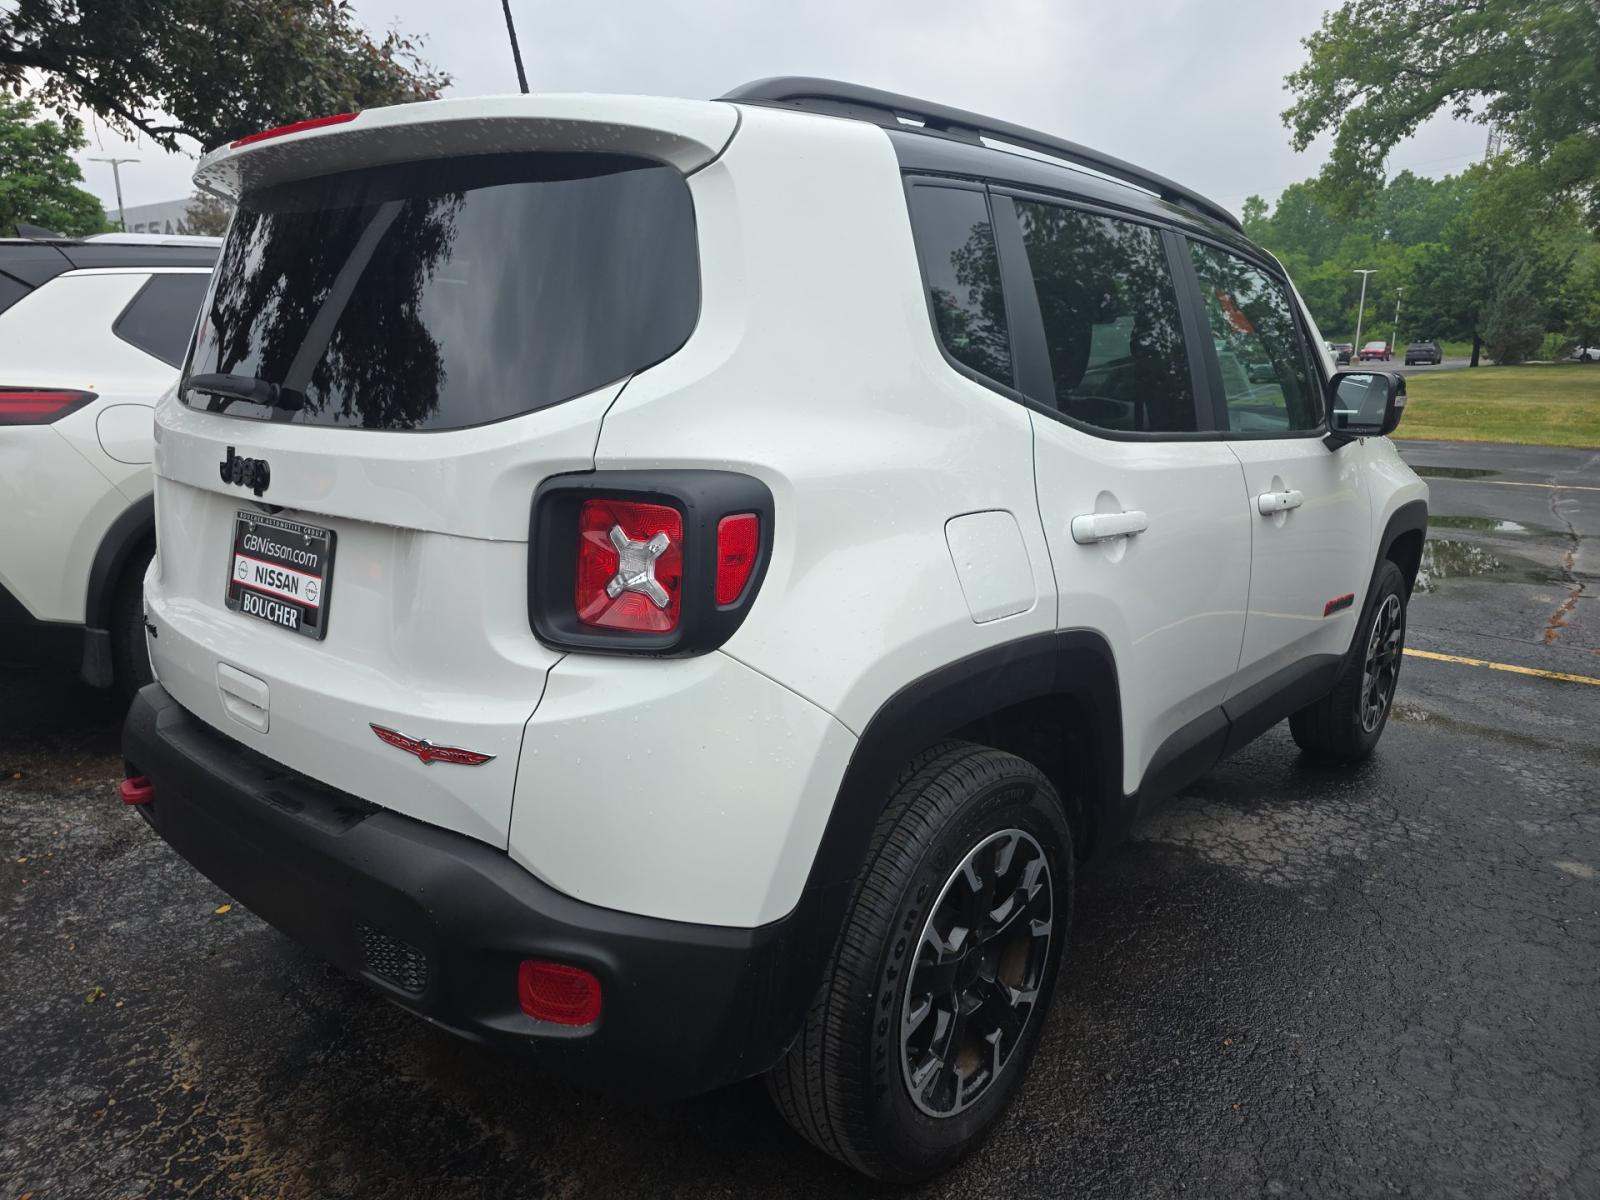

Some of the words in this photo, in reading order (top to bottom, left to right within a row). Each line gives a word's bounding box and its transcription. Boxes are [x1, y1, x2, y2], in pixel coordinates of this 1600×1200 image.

[243, 534, 318, 567] GBNissan.com
[254, 565, 299, 595] NISSAN
[243, 594, 298, 629] BOUCHER
